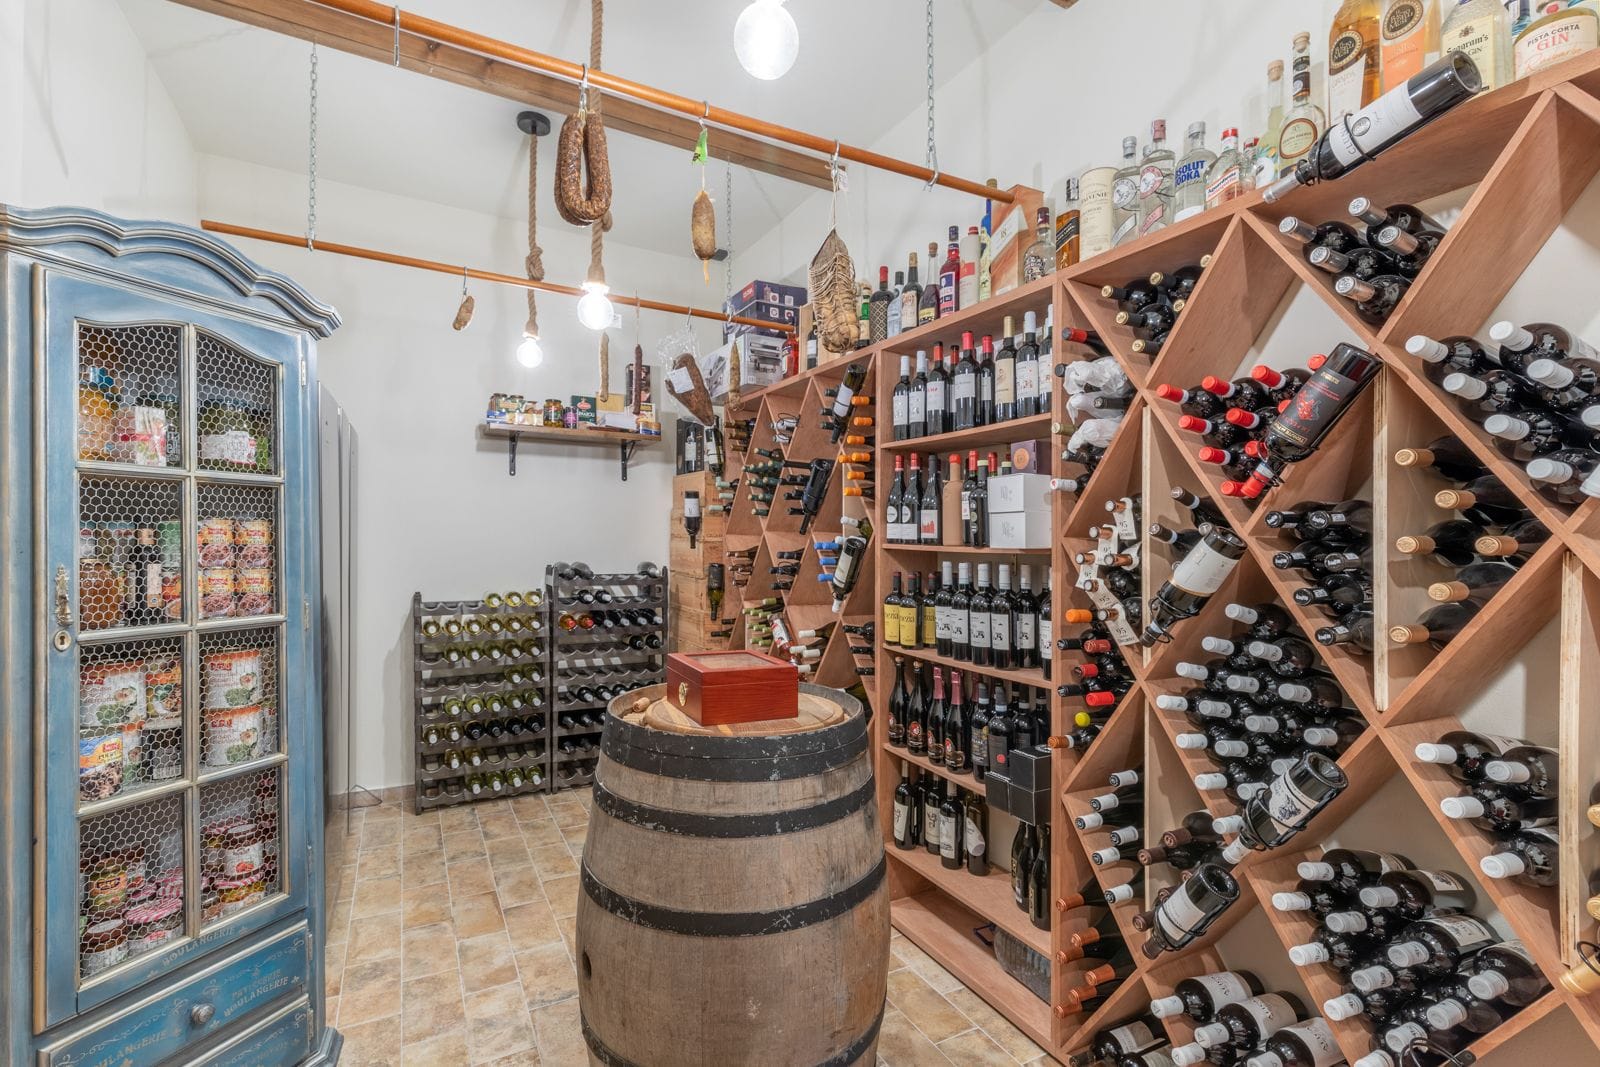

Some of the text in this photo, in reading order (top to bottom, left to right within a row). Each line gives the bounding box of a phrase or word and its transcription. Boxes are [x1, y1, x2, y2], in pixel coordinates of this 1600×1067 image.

[1528, 24, 1580, 47] PISTA CORTA
[1537, 32, 1569, 51] GIN
[224, 976, 289, 1017] BOULANGERIE
